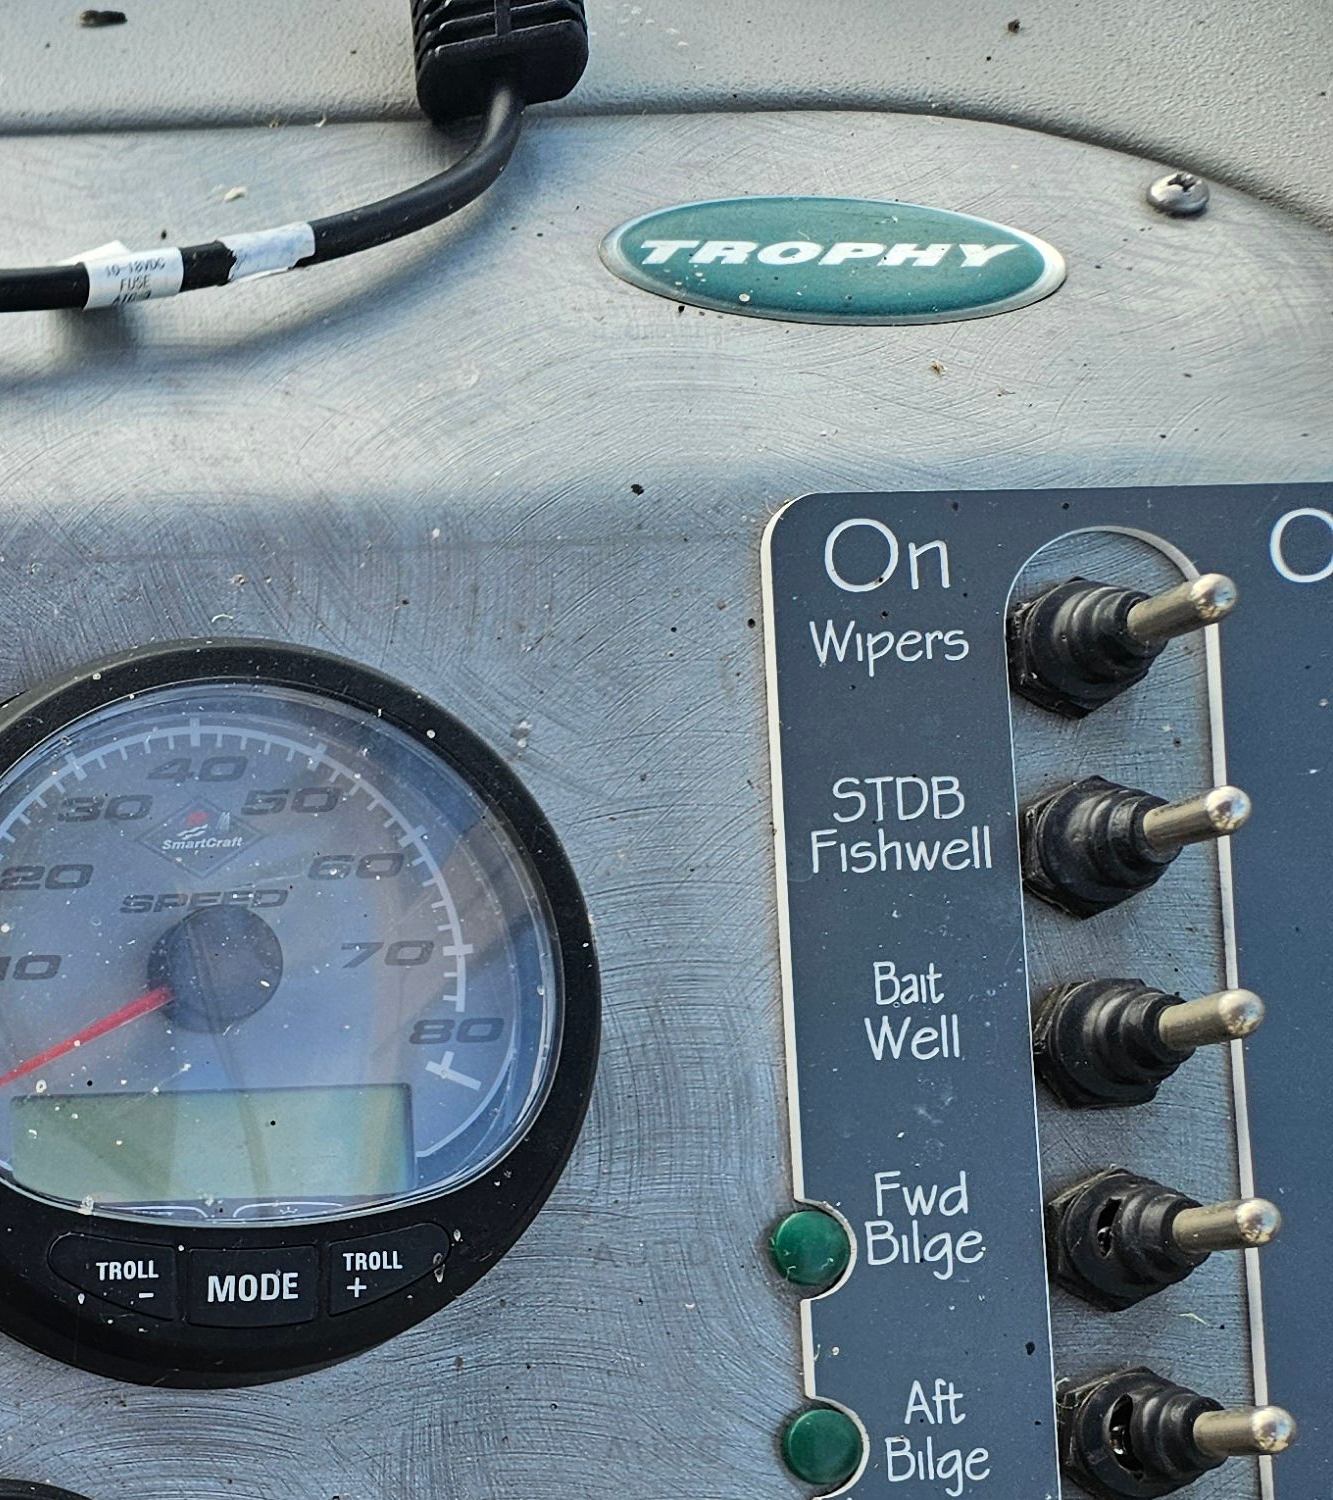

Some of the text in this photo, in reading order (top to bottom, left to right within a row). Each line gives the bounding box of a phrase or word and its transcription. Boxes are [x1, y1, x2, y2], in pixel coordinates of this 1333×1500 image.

[640, 239, 1022, 268] TROPHY
[119, 276, 151, 292] FUSE
[824, 518, 950, 593] On
[808, 619, 970, 678] Wipers
[148, 756, 247, 783] 40
[57, 795, 153, 821] 30
[241, 787, 343, 814] 50
[832, 775, 965, 824] STDB
[161, 835, 244, 850] SmartCraft
[810, 825, 993, 874] Fishwell
[307, 853, 404, 880] 60
[119, 889, 288, 913] SPEED
[340, 942, 433, 968] 70
[873, 960, 945, 1007] Bait
[409, 1017, 505, 1044] 80
[864, 1014, 961, 1061] Well
[874, 1171, 969, 1217] Fwd
[342, 1250, 403, 1272] TROLL
[865, 1220, 984, 1280] Bilge
[95, 1260, 159, 1281] TROLL
[207, 1273, 299, 1302] MODE
[904, 1378, 965, 1426] Aft
[885, 1435, 991, 1497] Bilge
